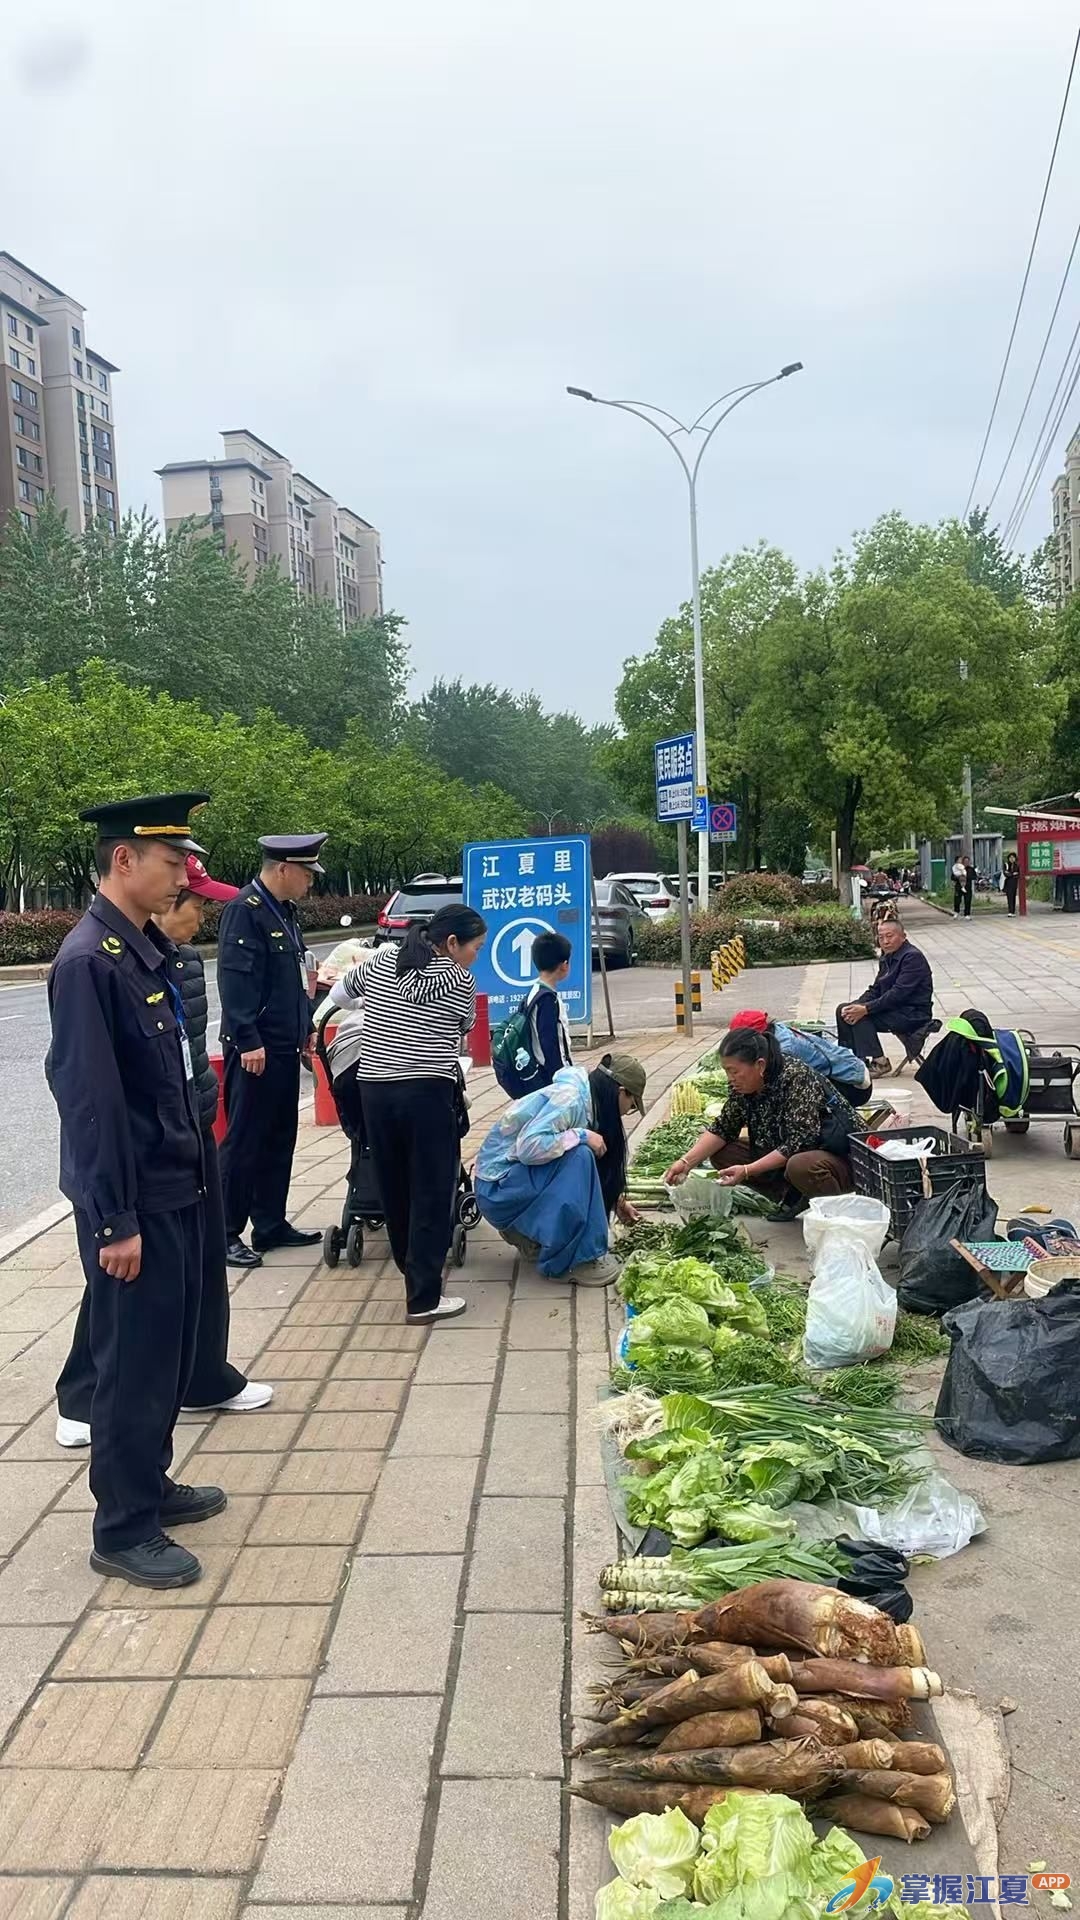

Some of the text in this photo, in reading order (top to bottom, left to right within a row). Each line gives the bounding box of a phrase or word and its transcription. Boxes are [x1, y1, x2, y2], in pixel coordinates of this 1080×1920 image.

[482, 849, 572, 878] 江夏里
[1031, 858, 1051, 868] 场所
[482, 882, 571, 910] 武汉老码头
